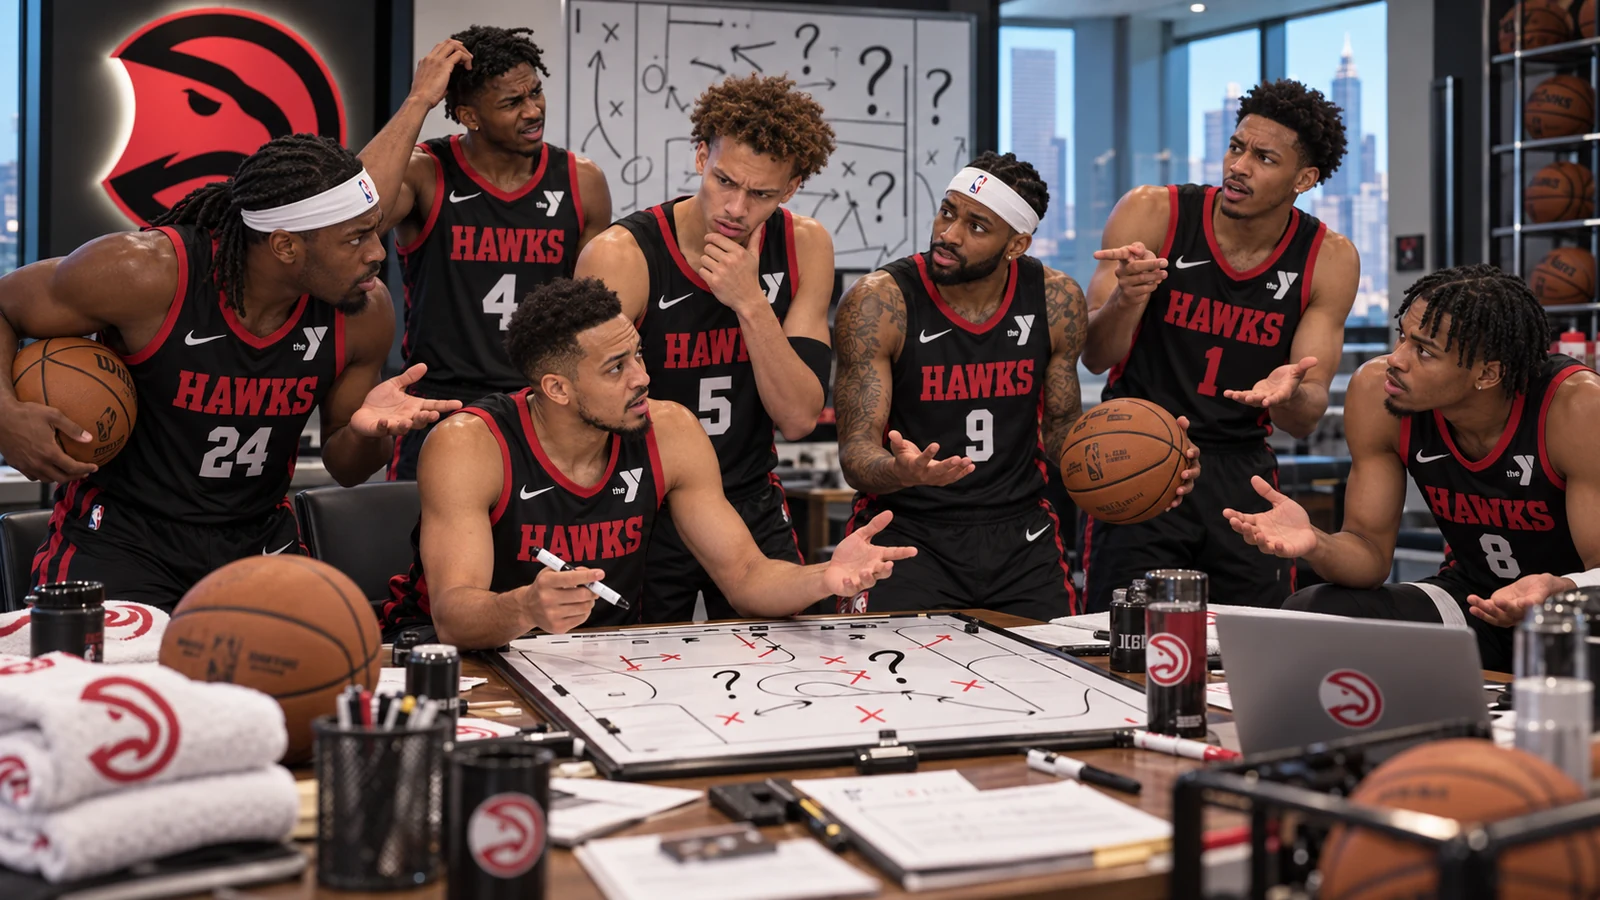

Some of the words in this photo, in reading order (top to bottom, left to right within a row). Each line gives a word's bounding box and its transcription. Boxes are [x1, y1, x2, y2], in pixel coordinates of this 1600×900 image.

[450, 226, 565, 264] HAWKS
[482, 273, 519, 331] 4
[1266, 282, 1278, 290] the
[1007, 329, 1019, 337] the
[1164, 289, 1285, 347] HAWKS
[293, 343, 306, 351] the
[172, 370, 318, 416] HAWKS
[920, 359, 1034, 401] HAWKS
[1197, 346, 1224, 397] 1
[698, 375, 732, 436] 5
[199, 426, 272, 478] 24
[965, 408, 994, 462] 9
[612, 487, 626, 495] the
[1506, 470, 1520, 478] the
[1424, 485, 1556, 532] HAWKS
[517, 515, 643, 562] HAWKS
[1478, 532, 1522, 579] 8
